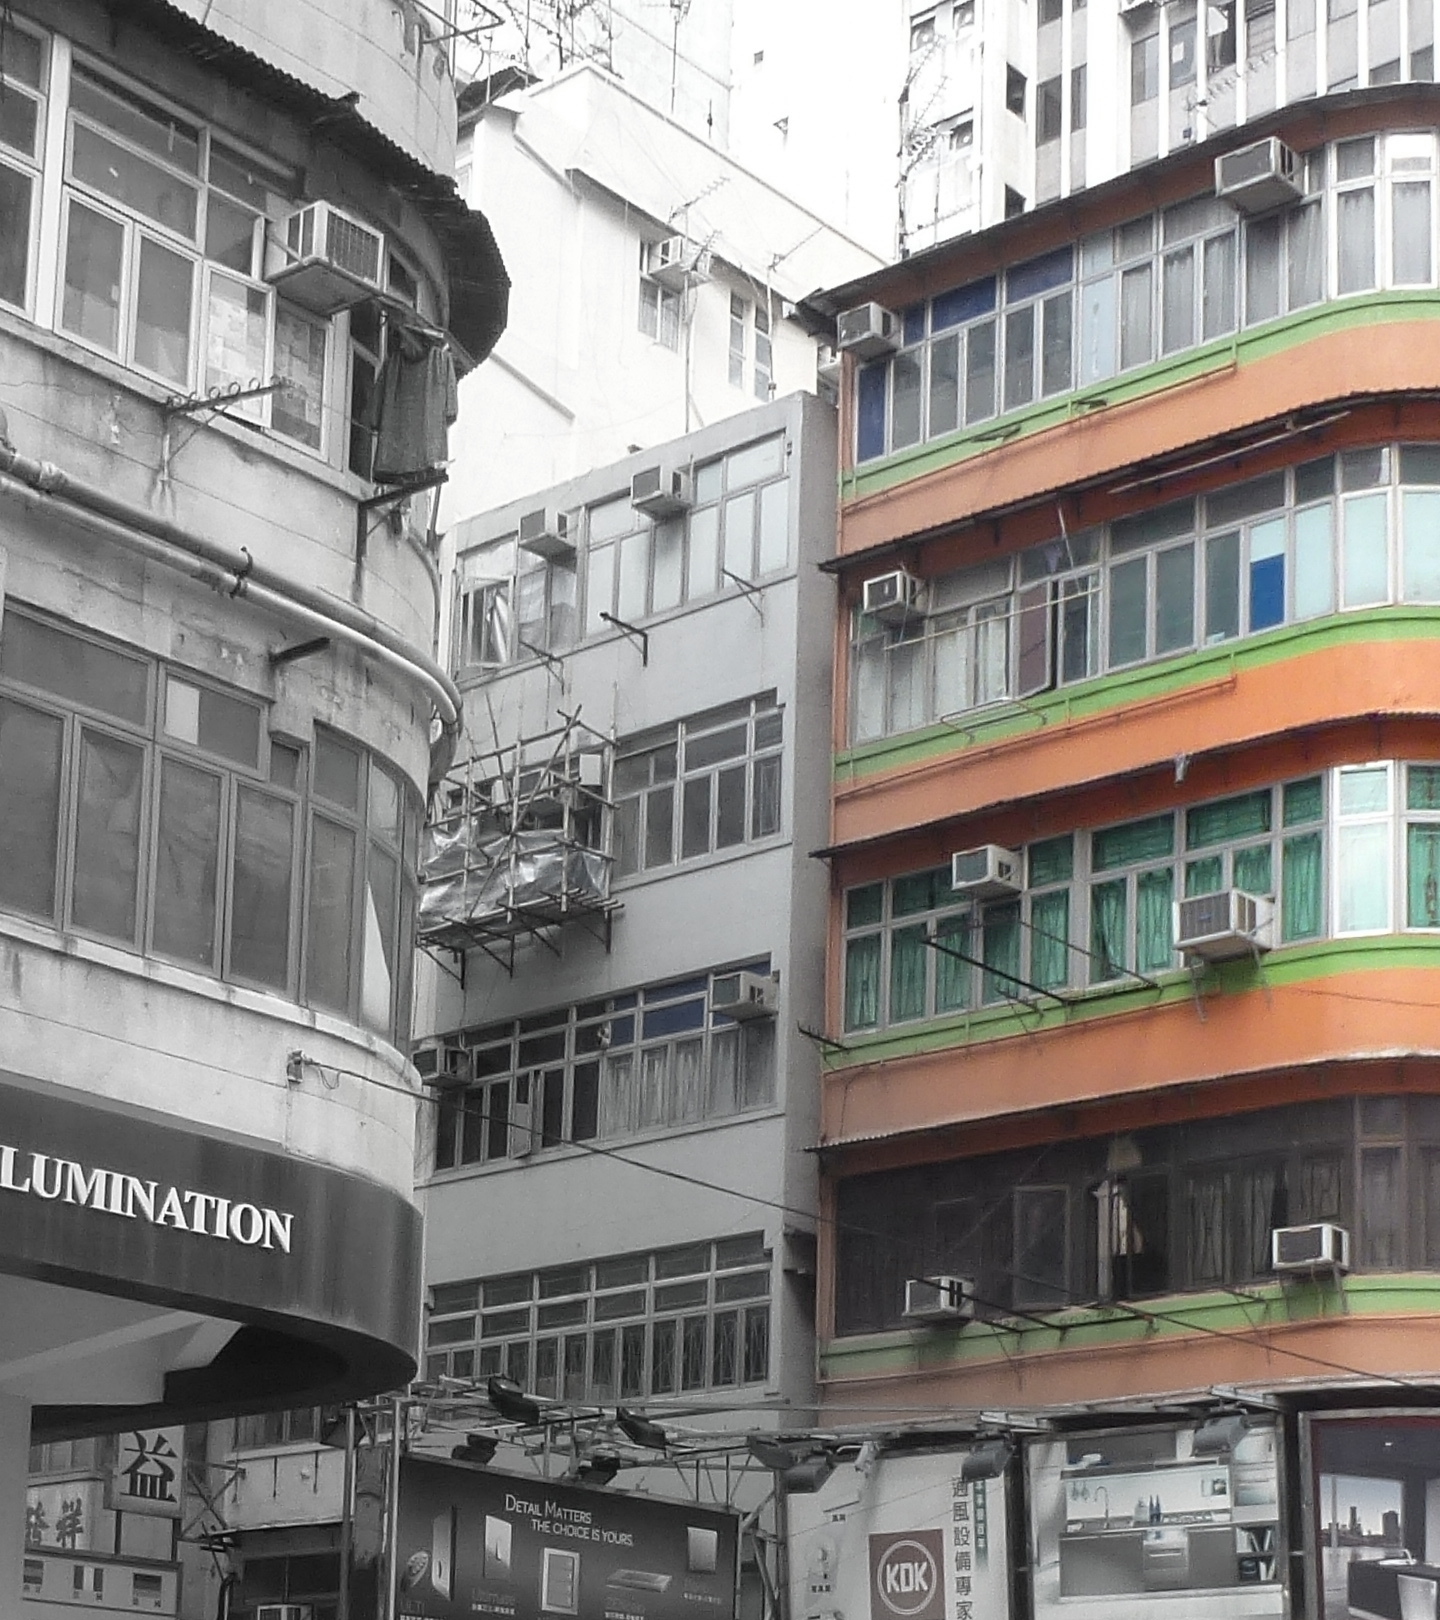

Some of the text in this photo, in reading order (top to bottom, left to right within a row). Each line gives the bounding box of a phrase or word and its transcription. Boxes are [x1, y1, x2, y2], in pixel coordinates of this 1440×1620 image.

[120, 1430, 178, 1503] 益
[505, 1494, 592, 1524] DETAIL MATTERS
[531, 1518, 551, 1534] THE
[552, 1523, 590, 1540] CHOICE
[592, 1529, 600, 1541] IS
[886, 1562, 928, 1594] KDK
